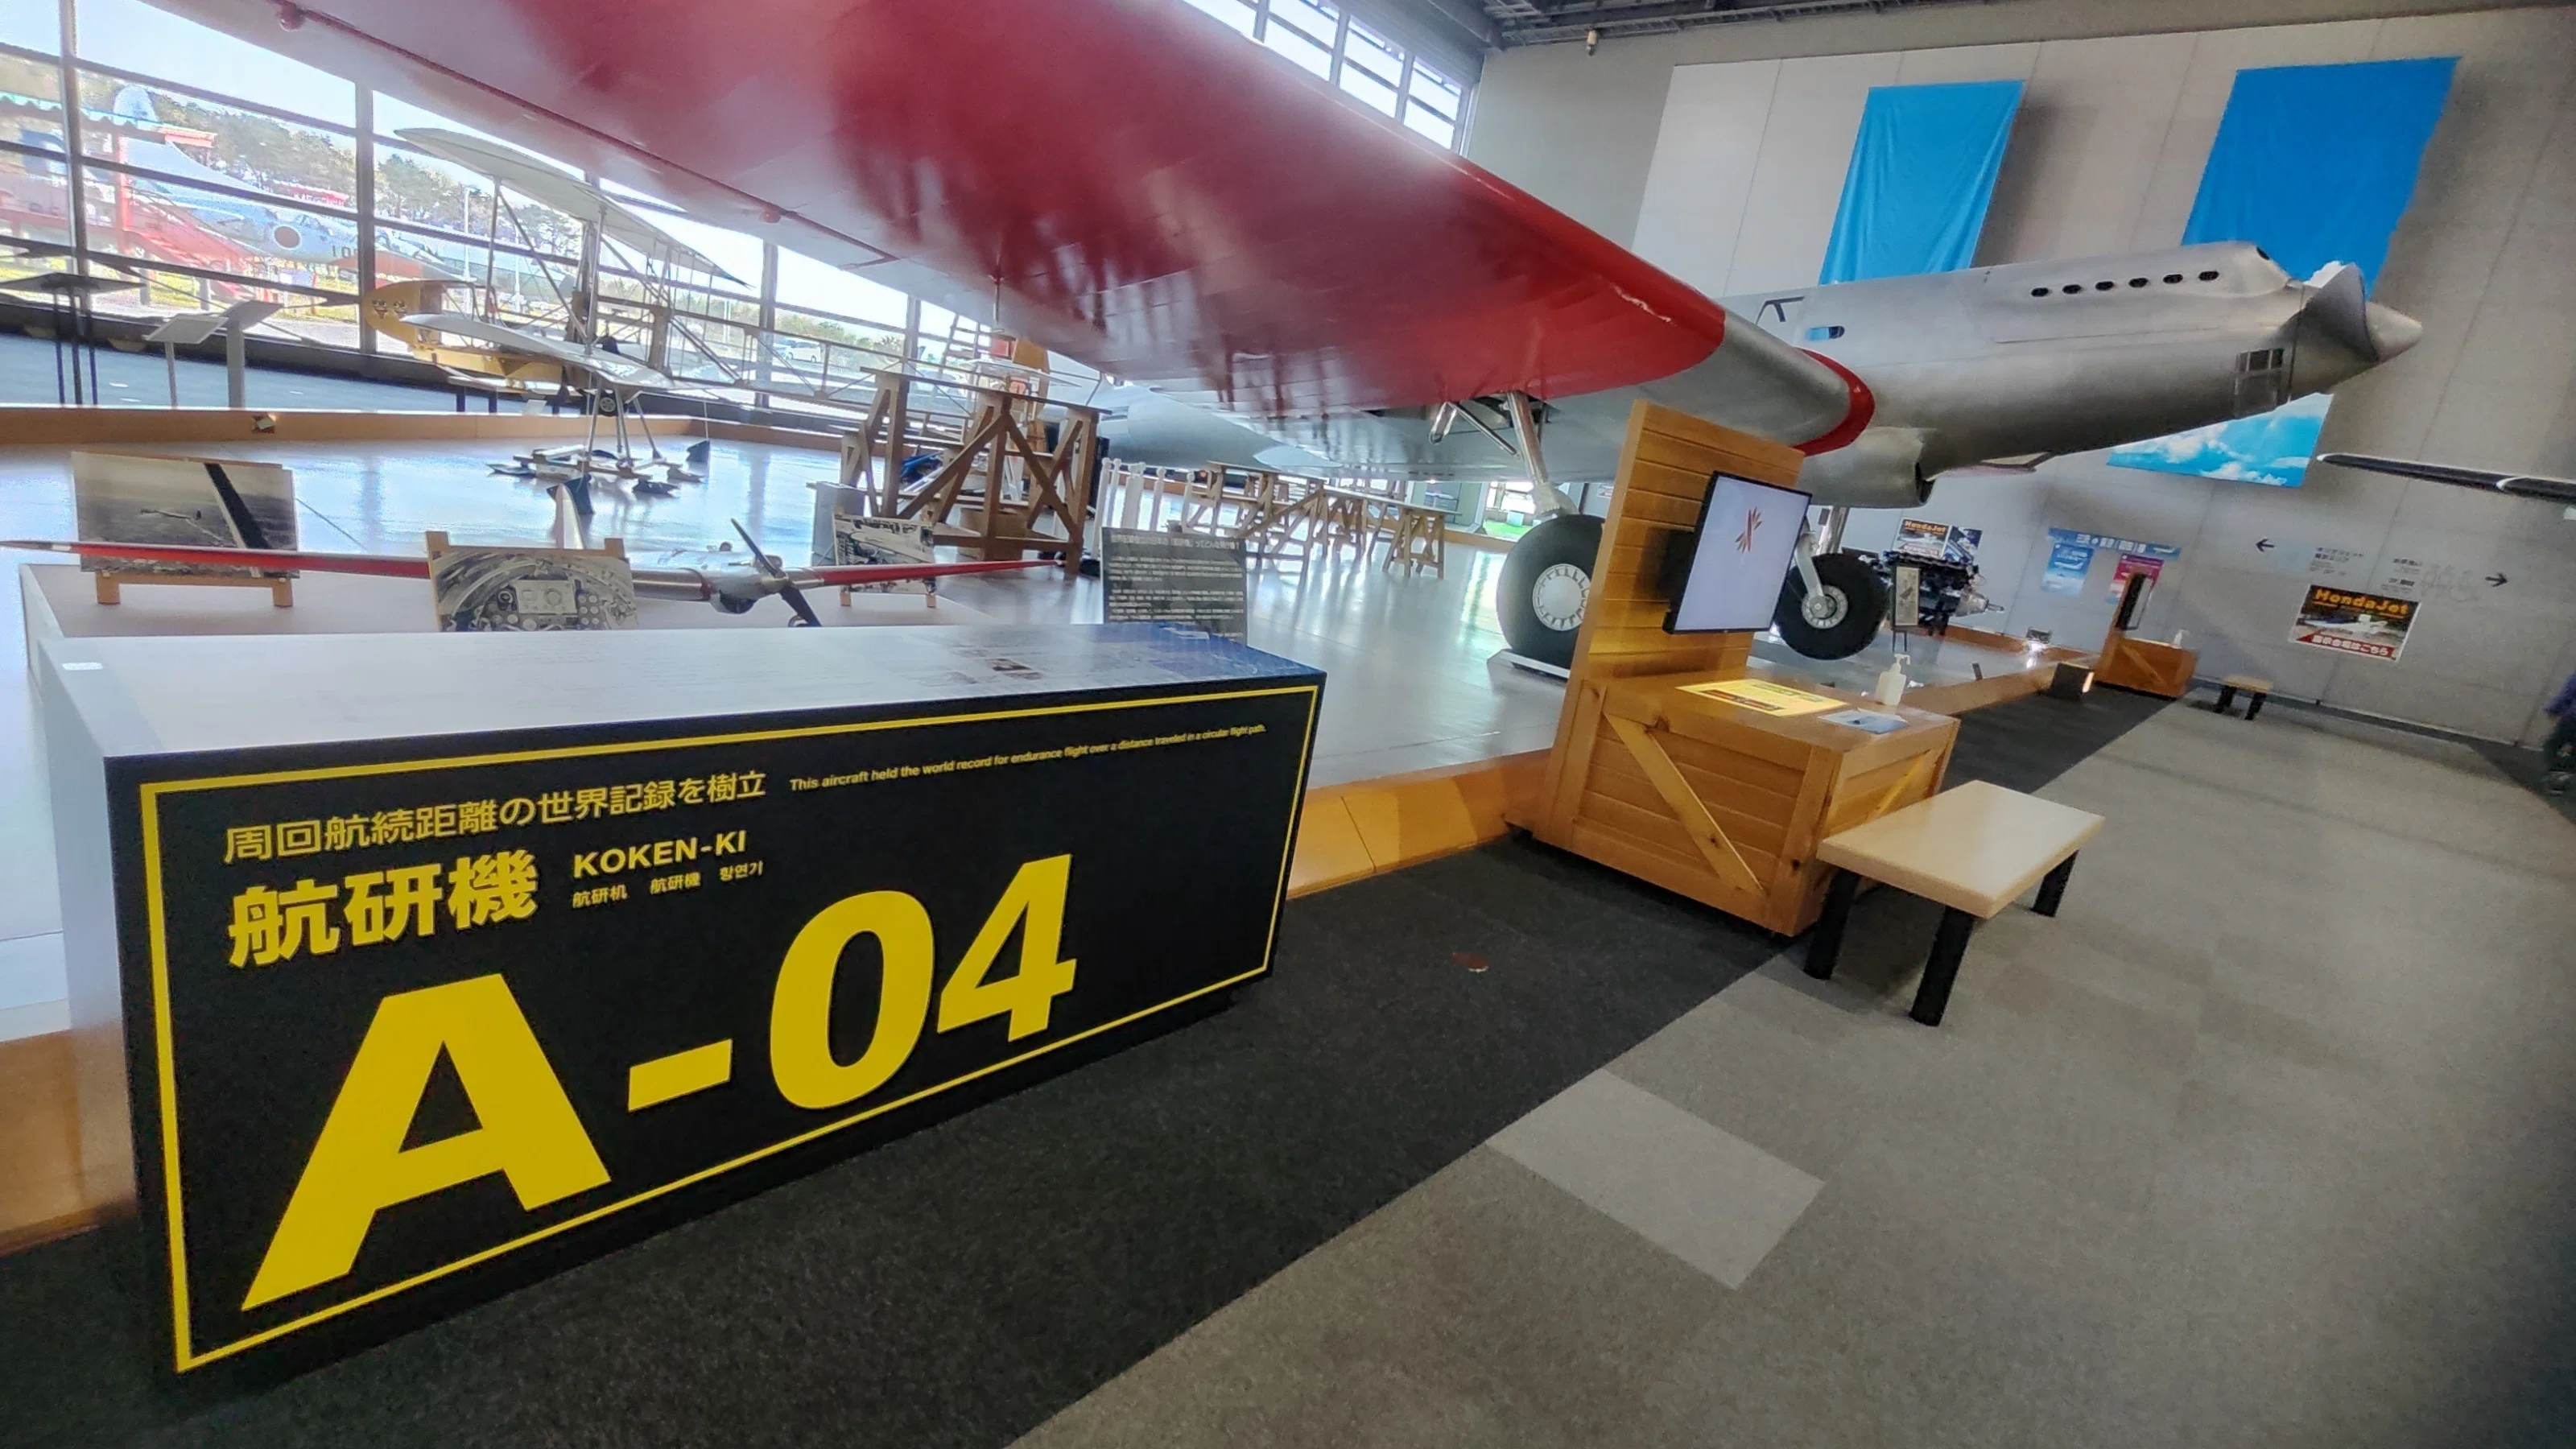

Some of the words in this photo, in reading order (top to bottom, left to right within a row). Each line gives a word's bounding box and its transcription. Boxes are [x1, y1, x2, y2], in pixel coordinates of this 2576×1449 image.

[332, 245, 358, 258] 10
[2314, 588, 2409, 616] HondaJet
[790, 778, 818, 791] This
[821, 770, 869, 787] aircraft
[871, 767, 898, 782] held
[900, 765, 922, 778] the
[922, 761, 956, 775] world
[956, 756, 993, 770] record
[993, 754, 1009, 766] for
[1010, 749, 1063, 764] endurance
[1063, 745, 1089, 759] flight
[1089, 743, 1110, 753] over
[1118, 738, 1154, 750] distance
[1154, 733, 1187, 745] traveled
[1202, 729, 1229, 740] circular
[224, 770, 766, 863] 周回航続距離の世界記録を樹立
[572, 829, 747, 880] KOKEN-KI
[227, 848, 539, 968] 航研機
[572, 884, 629, 909] 航研机
[242, 854, 1077, 1312] A-04
